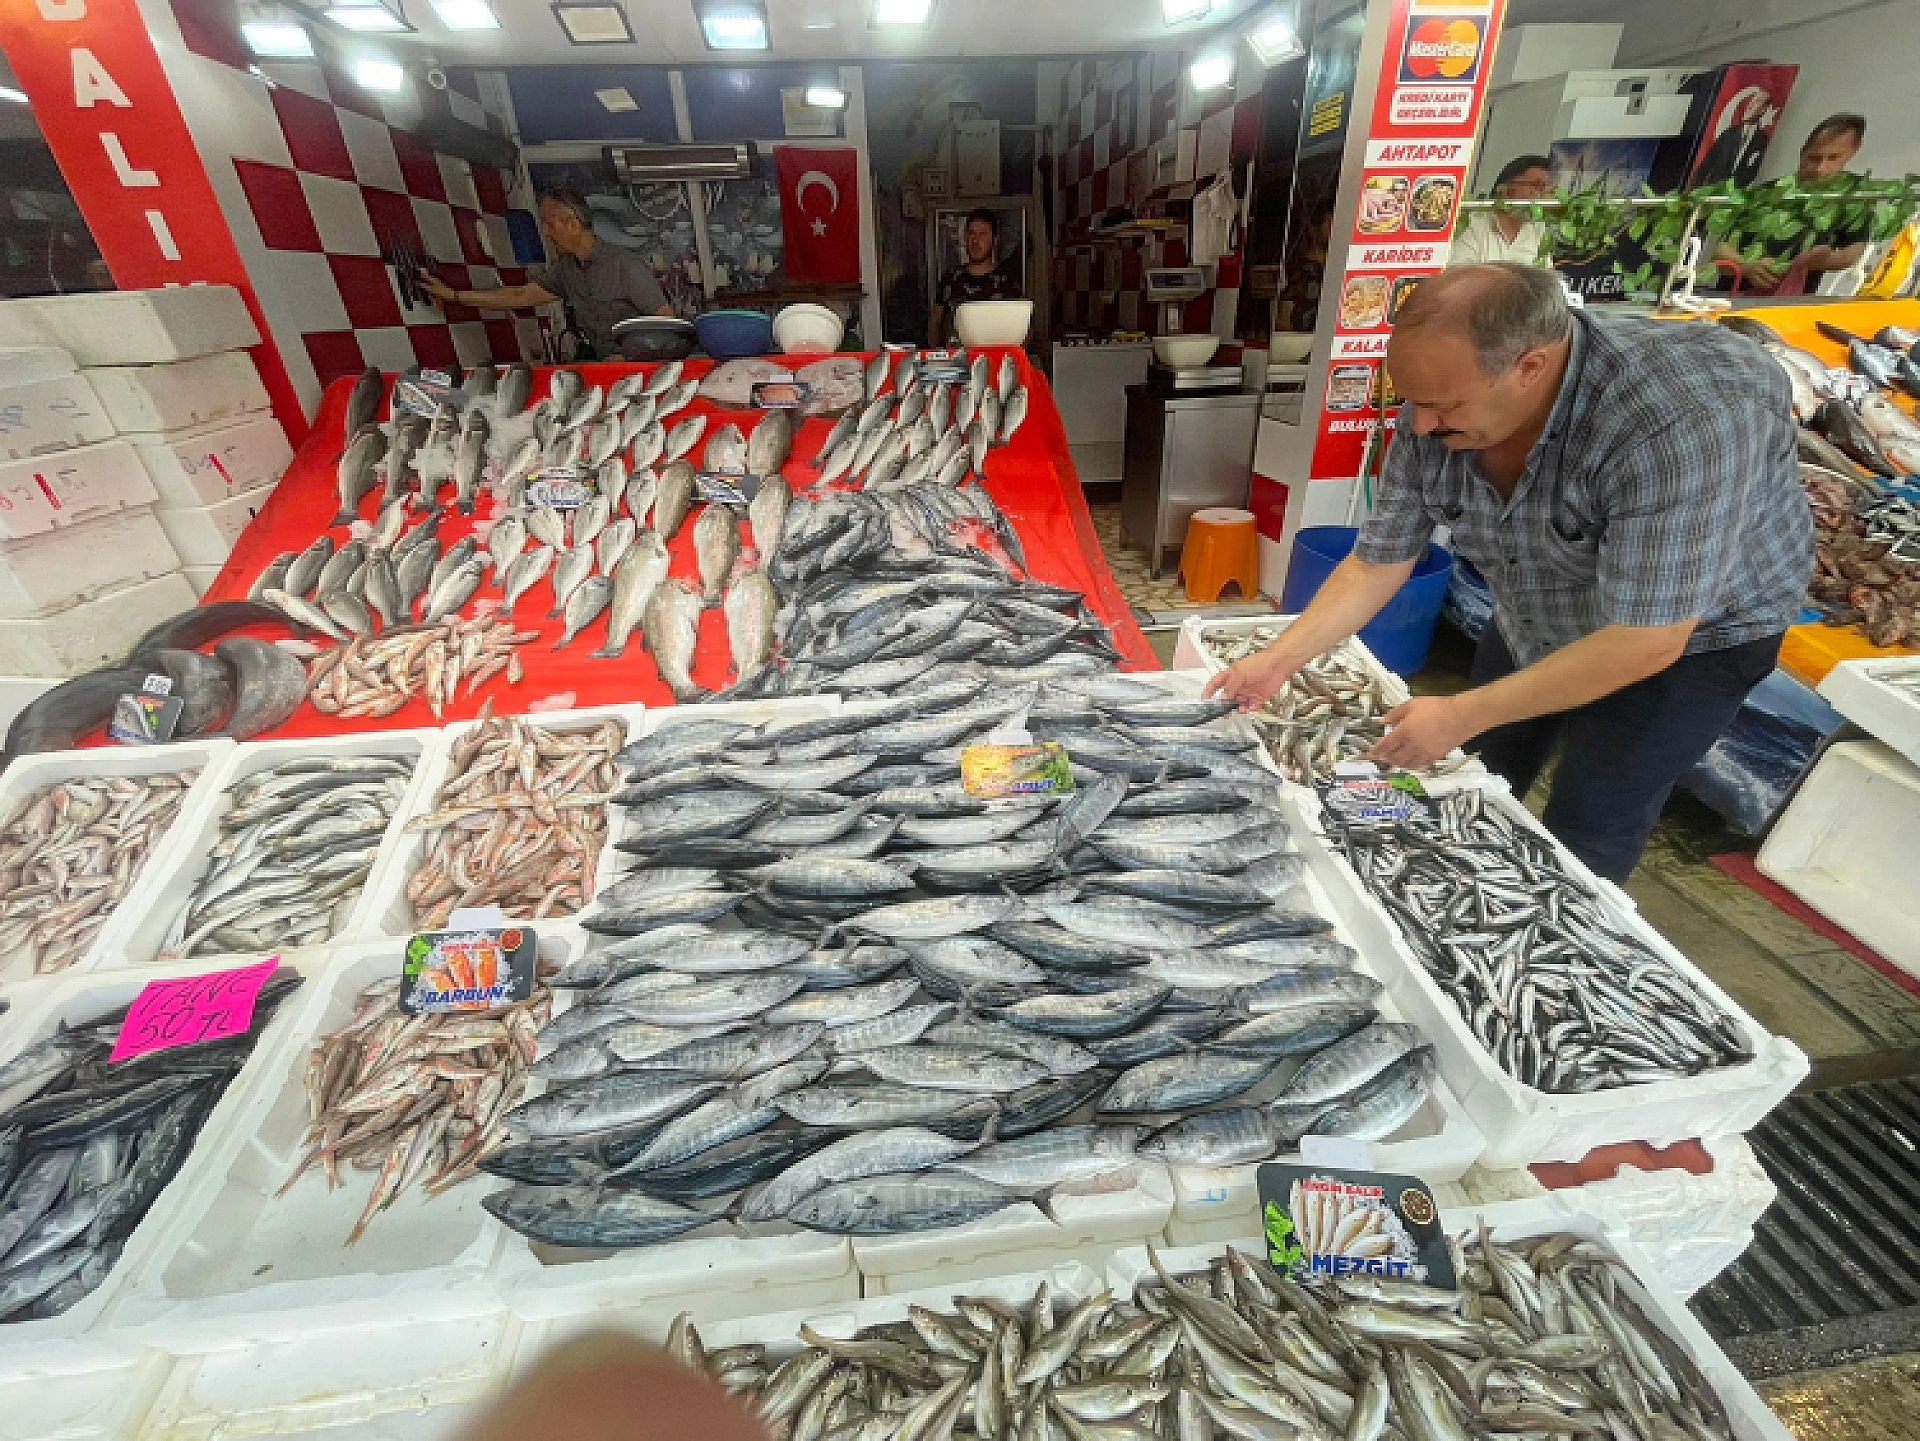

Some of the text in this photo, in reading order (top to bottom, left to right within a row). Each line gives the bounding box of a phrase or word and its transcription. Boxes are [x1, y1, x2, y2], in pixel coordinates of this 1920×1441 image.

[36, 0, 208, 288] ALI
[1376, 144, 1462, 161] AHTAPOT
[1361, 244, 1434, 263] KARİDES
[130, 1006, 195, 1049] 50
